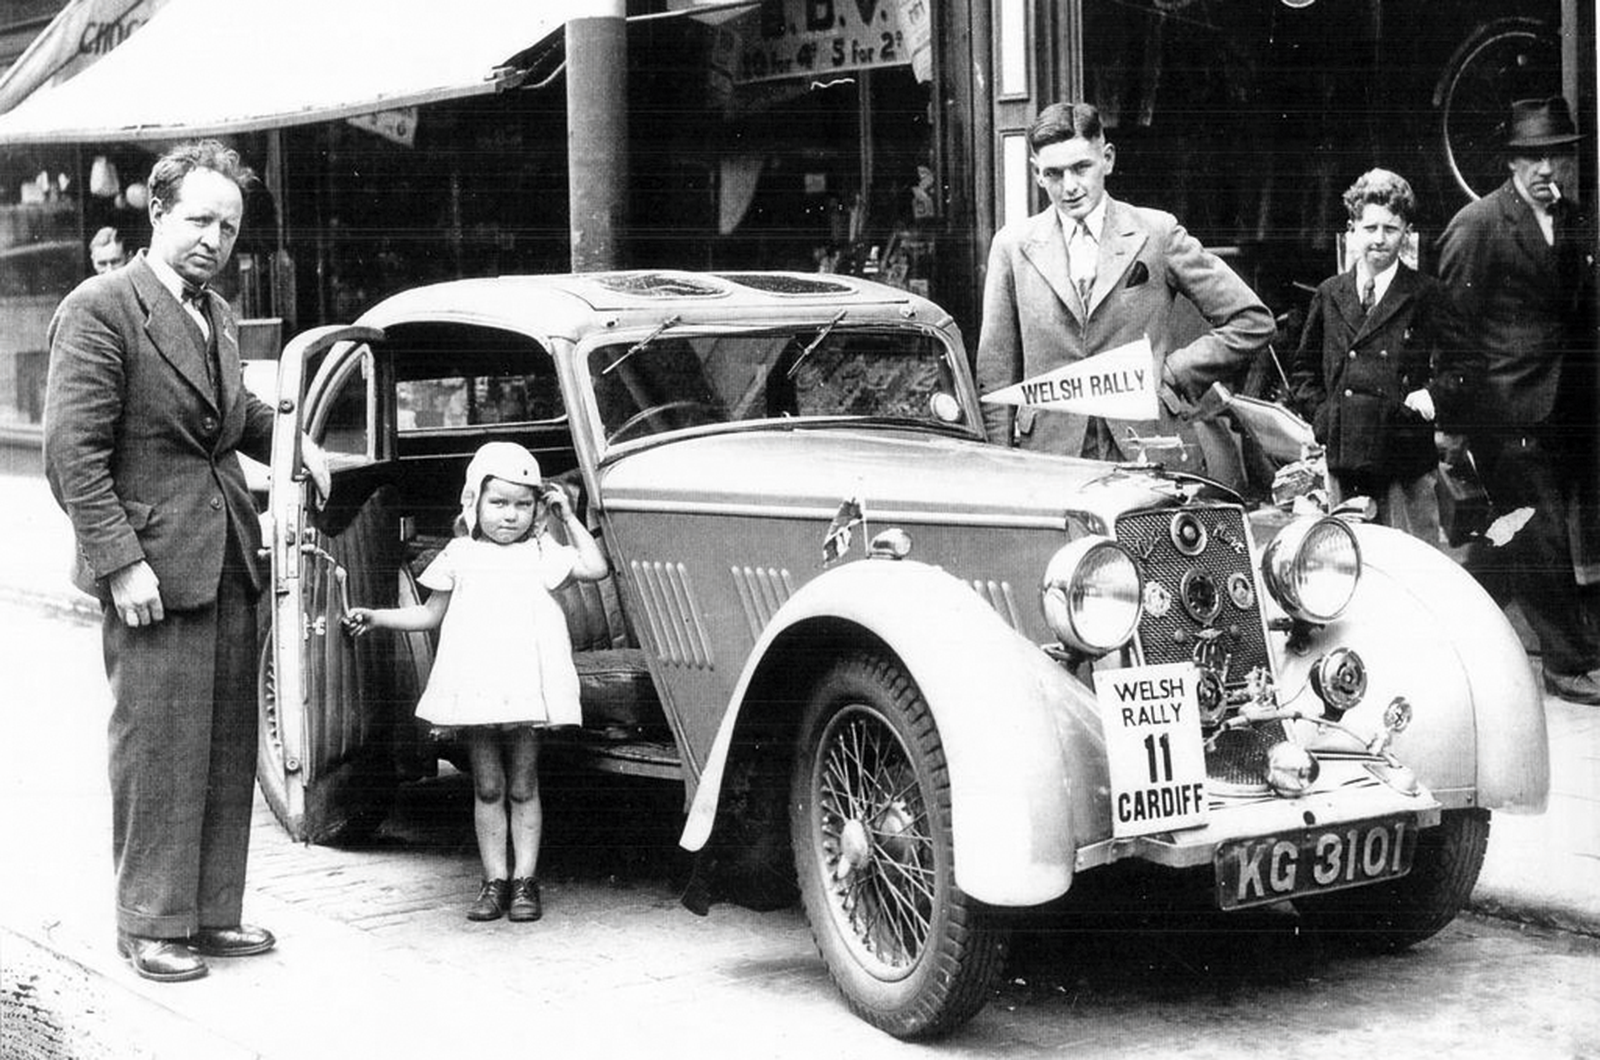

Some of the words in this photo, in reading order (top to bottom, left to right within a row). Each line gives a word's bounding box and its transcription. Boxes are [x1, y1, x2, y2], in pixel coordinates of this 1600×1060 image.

[852, 38, 875, 64] for
[1021, 377, 1084, 405] WELSH
[1089, 369, 1145, 397] RALLY
[1114, 678, 1185, 702] WELSH
[1122, 703, 1182, 727] RALLY
[1144, 732, 1173, 783] 11
[1117, 783, 1203, 822] CARDIFF
[1237, 841, 1299, 900] KG
[1313, 823, 1406, 885] 3101
